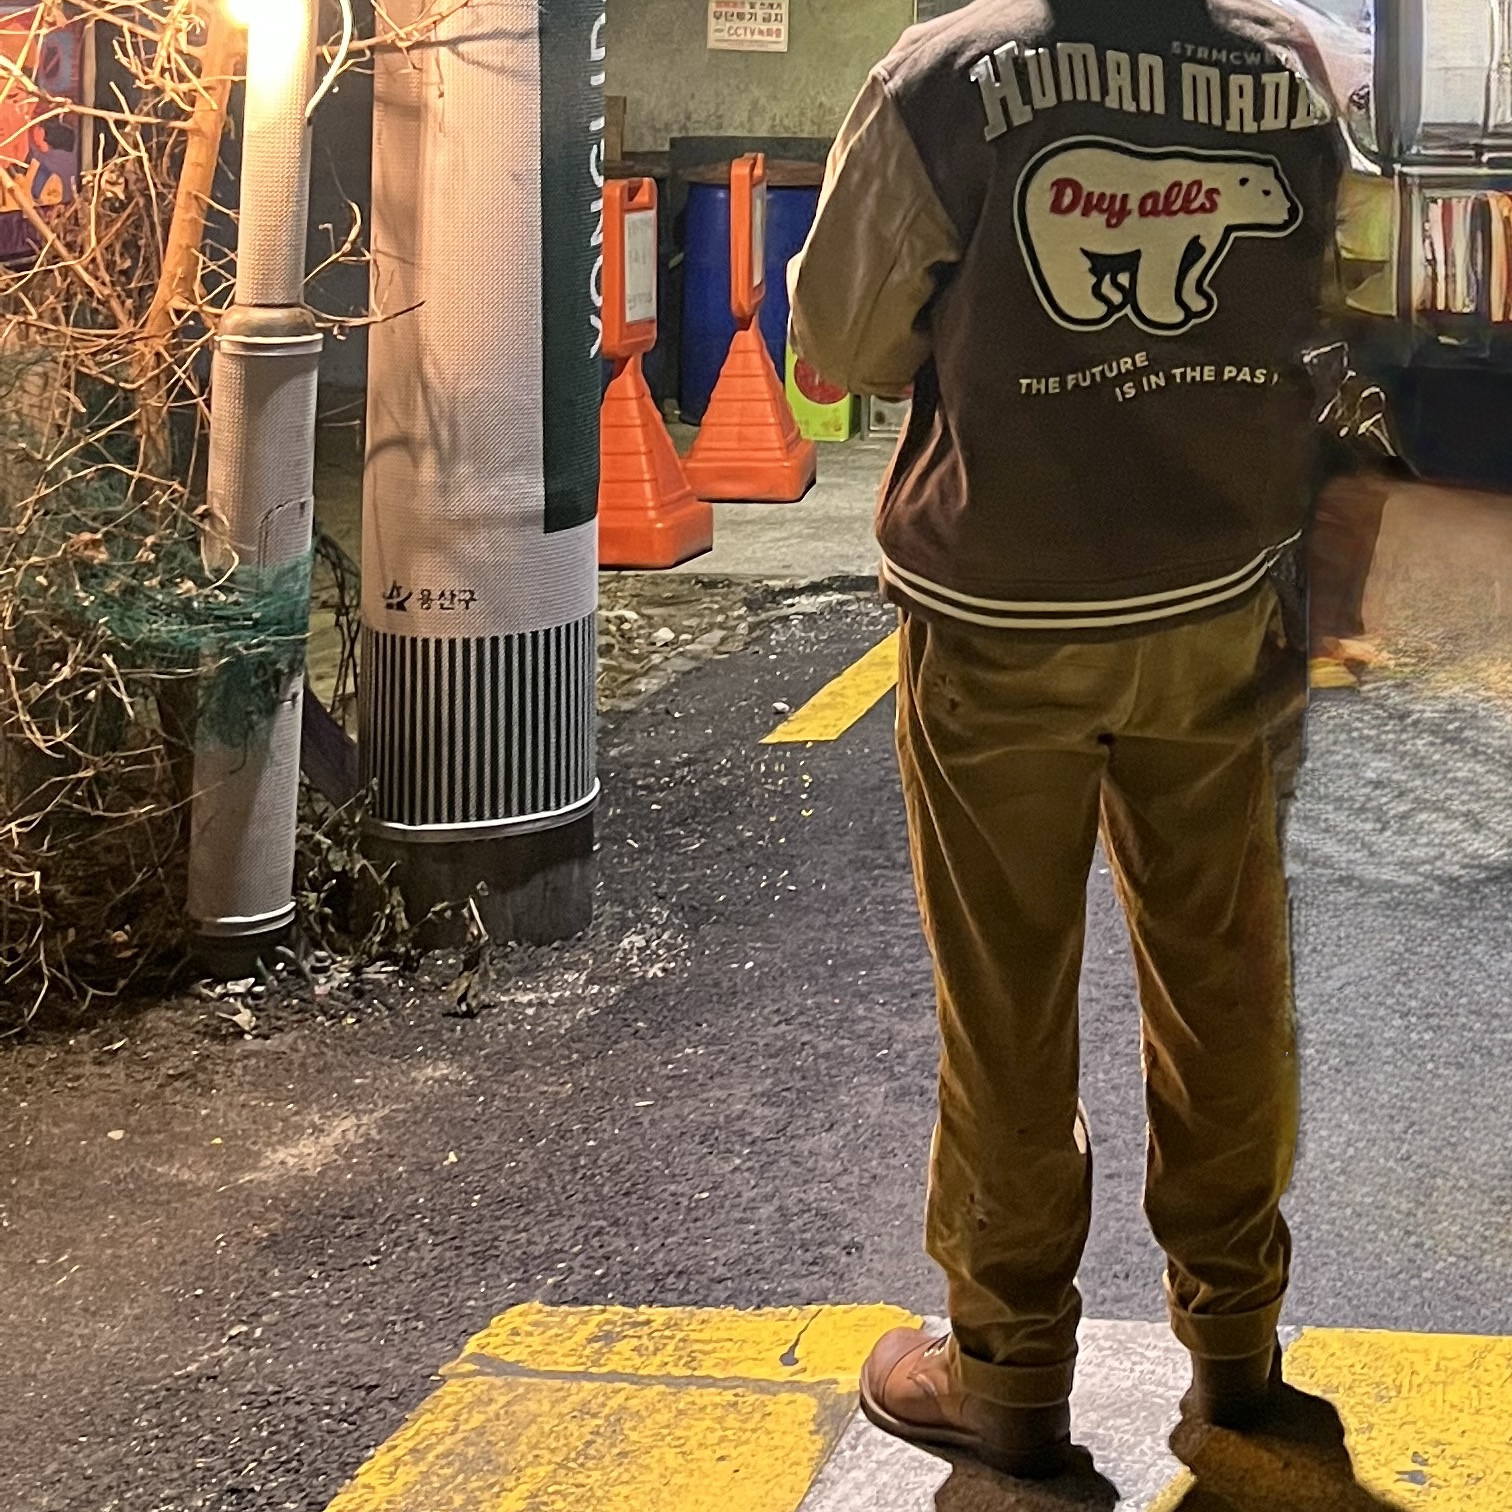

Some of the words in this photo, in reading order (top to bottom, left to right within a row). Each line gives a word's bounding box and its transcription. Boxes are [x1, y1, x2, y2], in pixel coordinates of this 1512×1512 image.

[713, 11, 758, 23] 무단투기
[762, 13, 783, 24] 금지
[969, 40, 1166, 141] HUMAN
[1049, 177, 1131, 228] Dry
[1138, 180, 1221, 221] alls
[1019, 376, 1060, 396] THE
[1066, 351, 1150, 390] FUTURE
[1115, 382, 1136, 402] IS
[1143, 371, 1166, 392] IN
[1171, 365, 1216, 385] THE
[417, 588, 478, 611] 용산구
